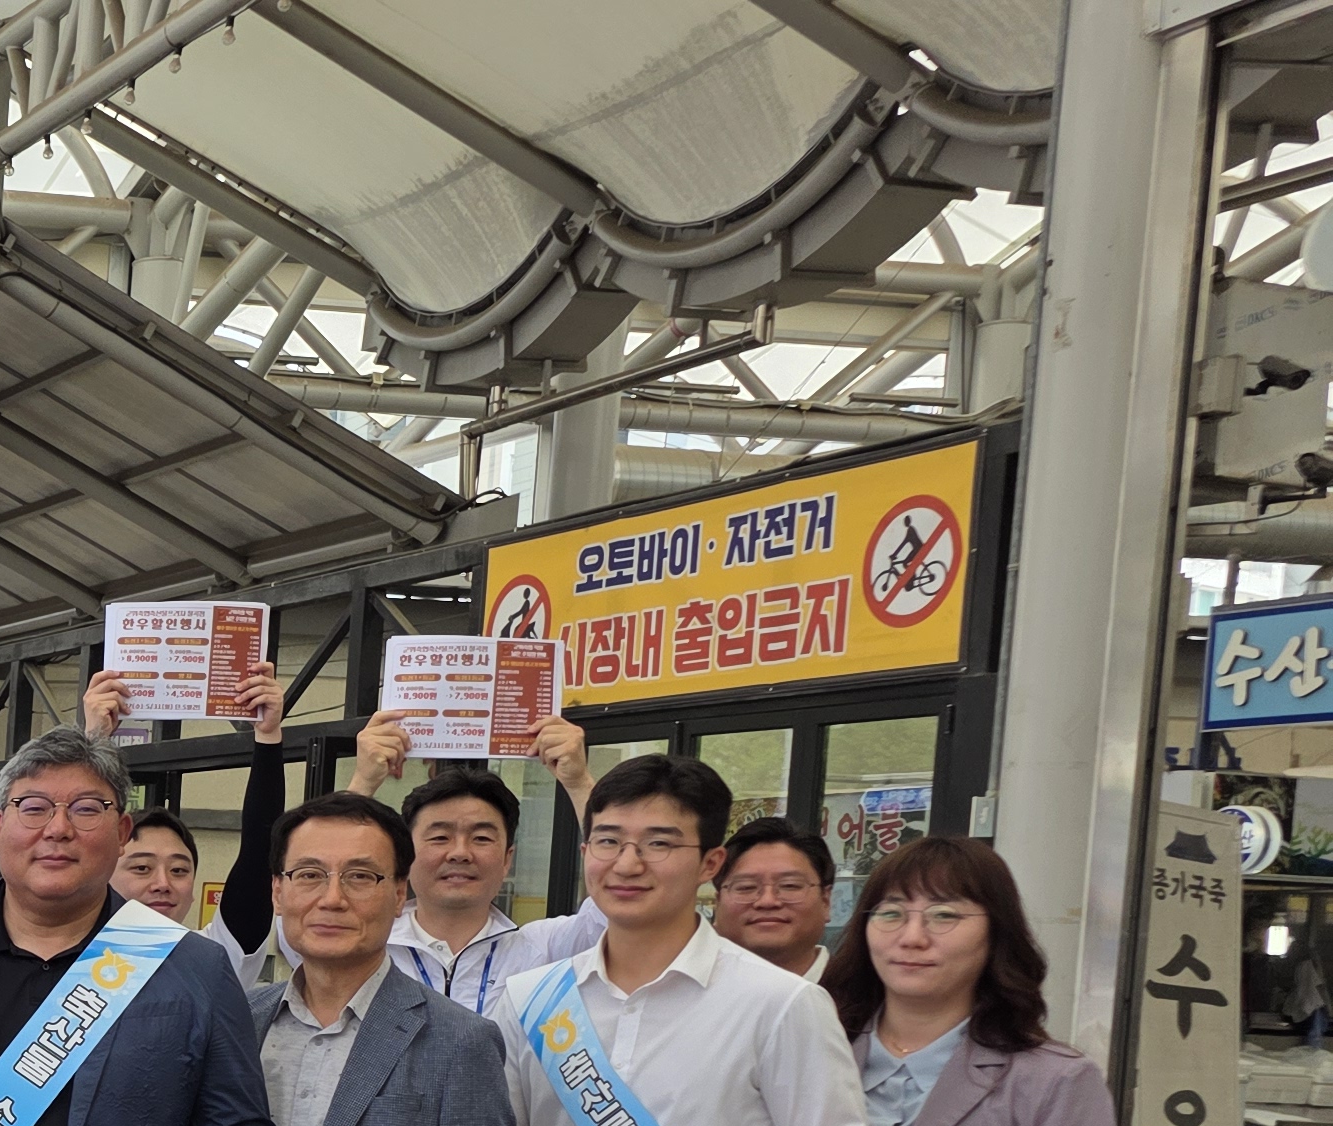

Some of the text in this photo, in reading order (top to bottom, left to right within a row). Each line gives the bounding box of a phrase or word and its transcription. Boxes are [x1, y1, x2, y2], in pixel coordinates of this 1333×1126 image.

[673, 576, 853, 676] 출입금지
[1214, 626, 1333, 706] 수산
[13, 984, 109, 1089] 축산물
